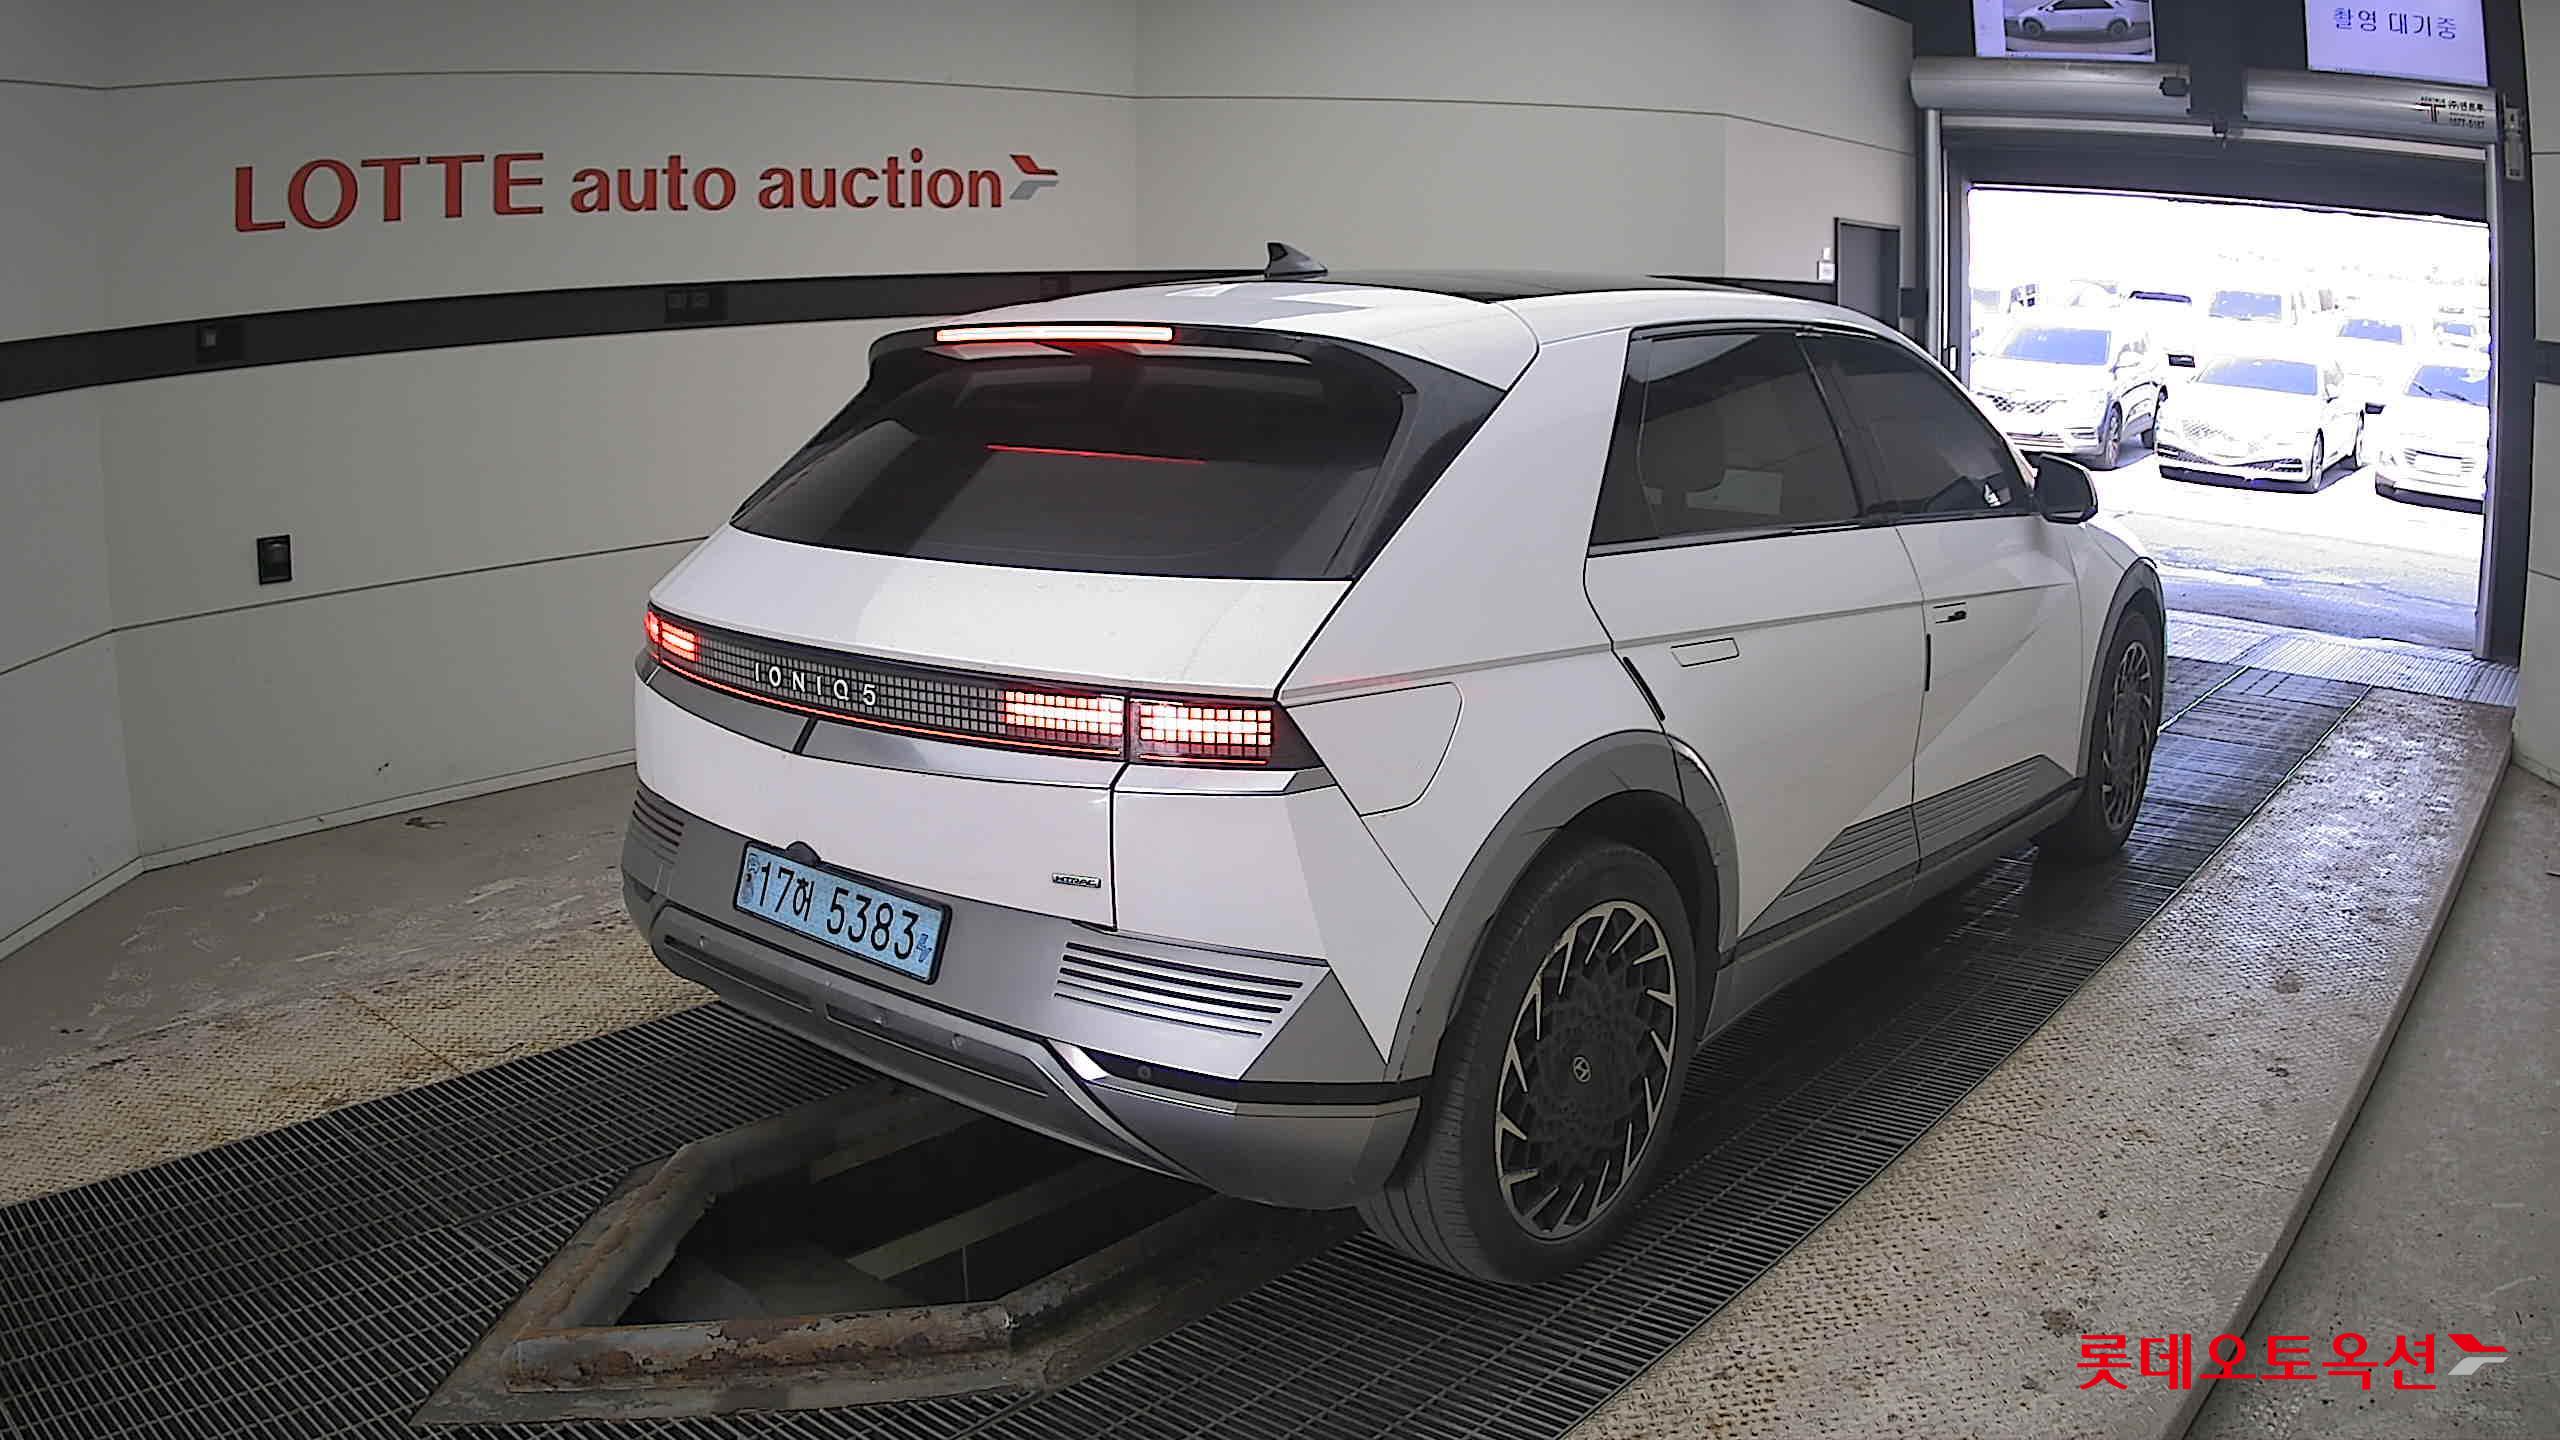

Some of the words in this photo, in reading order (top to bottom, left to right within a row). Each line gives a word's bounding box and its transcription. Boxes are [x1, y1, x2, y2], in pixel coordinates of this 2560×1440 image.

[2389, 13, 2457, 40] 대기중
[234, 152, 544, 232] LOTTE
[571, 154, 737, 211] auto
[758, 148, 1004, 209] auction
[754, 662, 849, 701] IONIQ
[862, 683, 876, 706] 5
[826, 886, 920, 960] 5383
